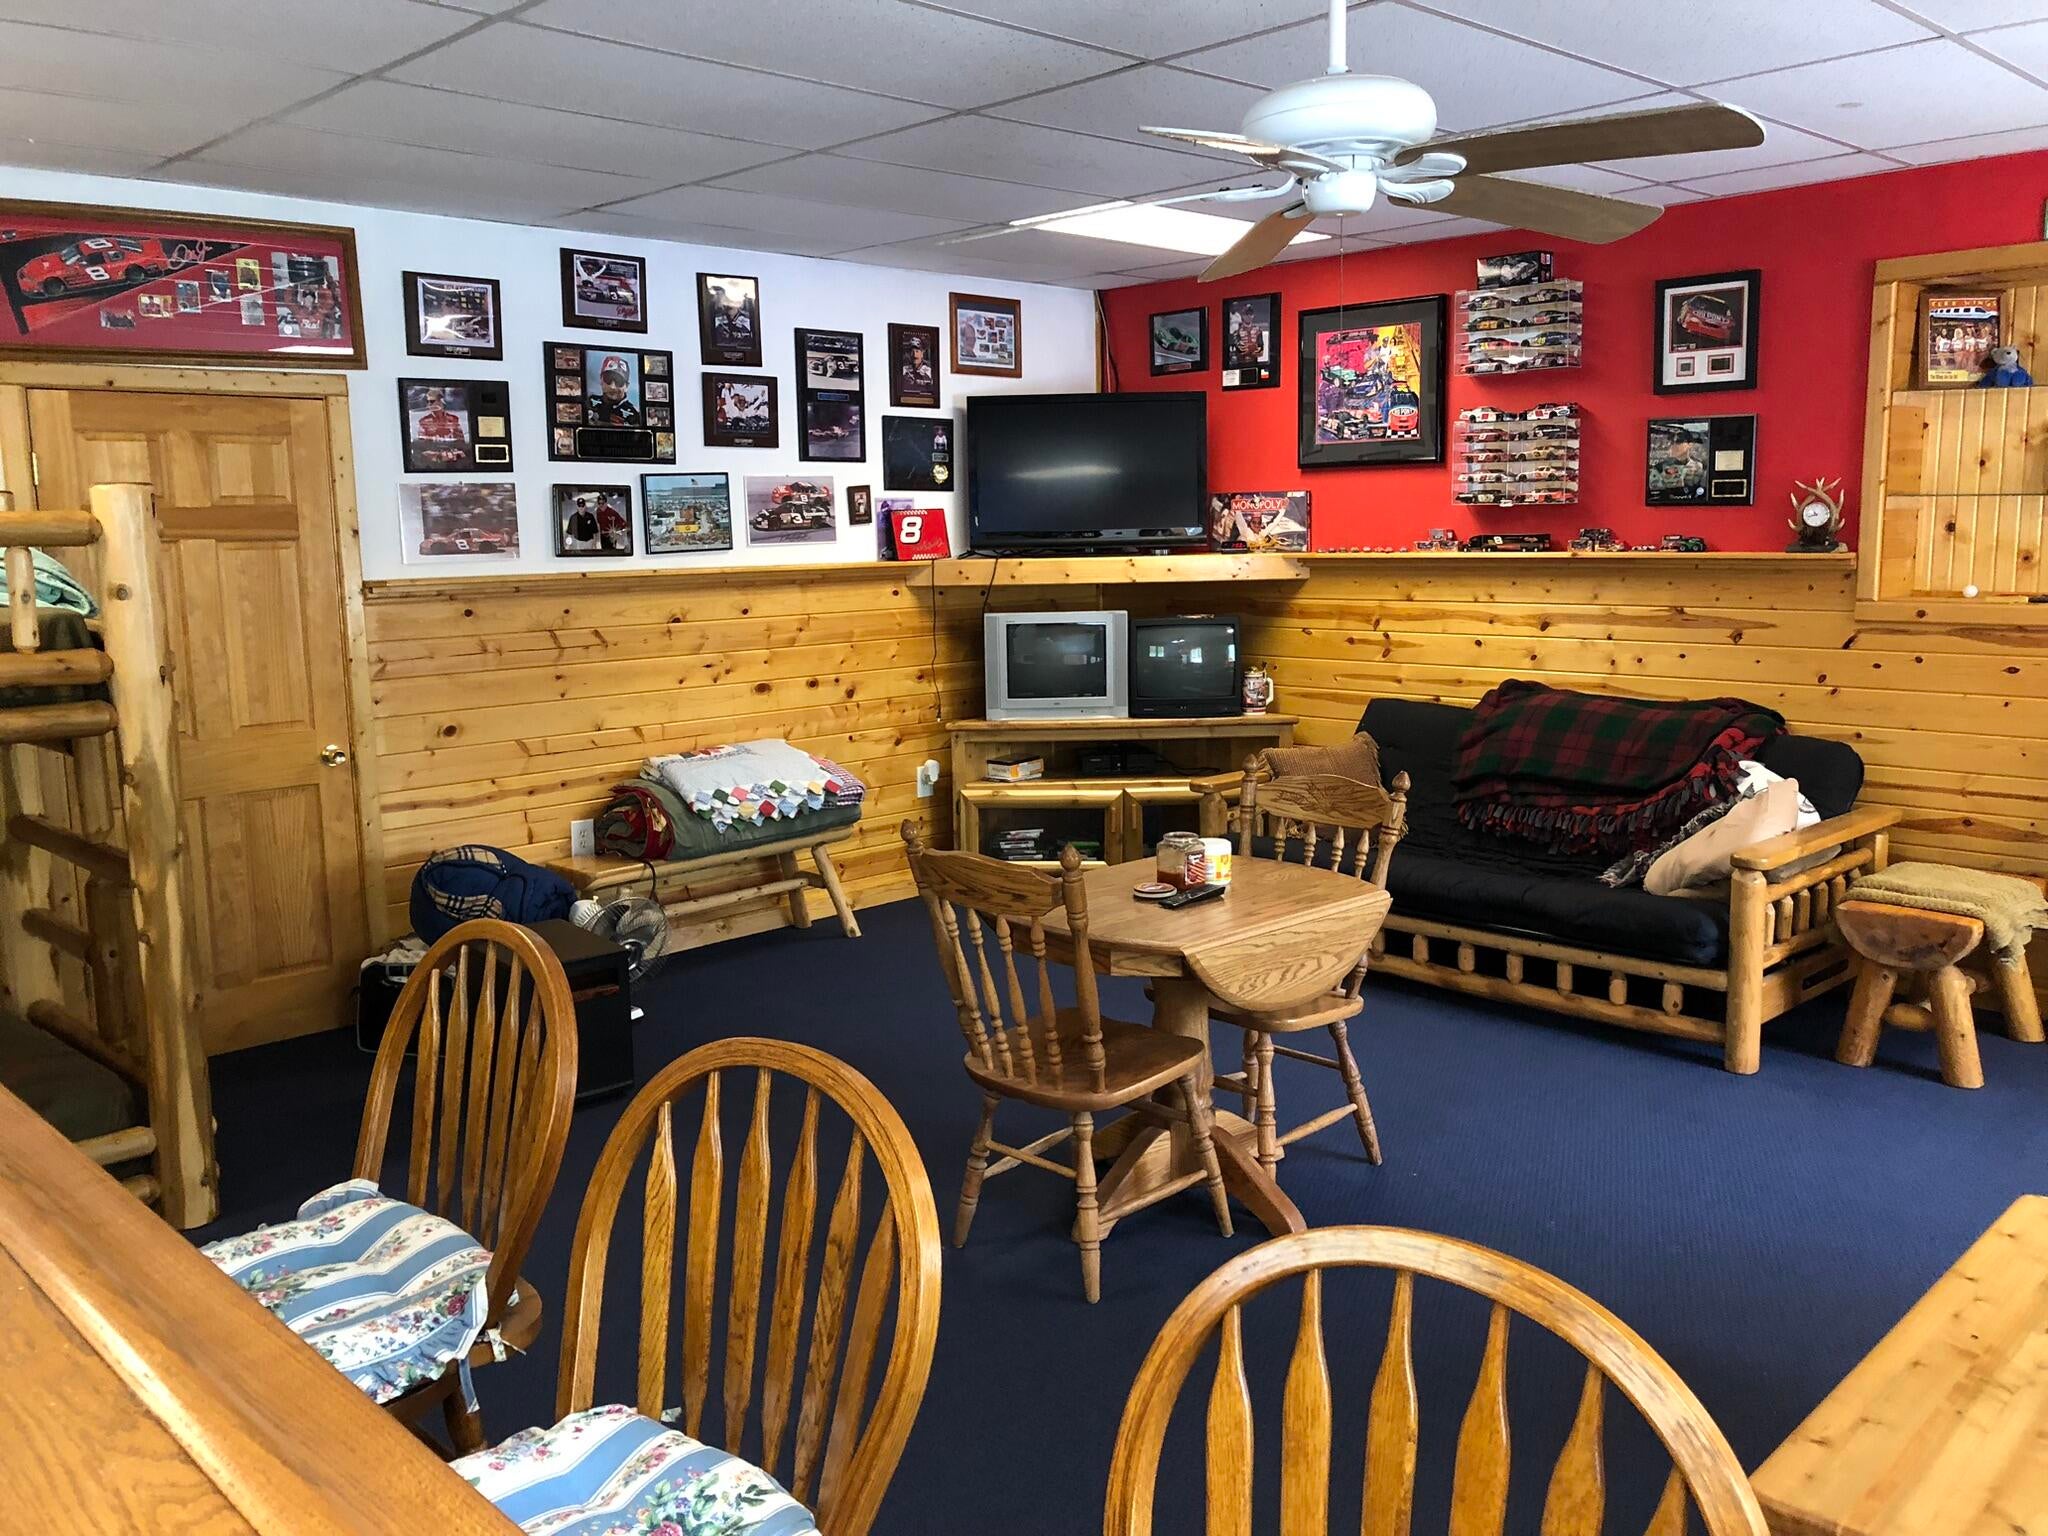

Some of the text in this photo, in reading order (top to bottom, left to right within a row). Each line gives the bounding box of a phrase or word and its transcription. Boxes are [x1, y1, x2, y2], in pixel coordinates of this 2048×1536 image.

[85, 266, 110, 281] 8
[610, 291, 618, 300] 3
[837, 361, 845, 370] 3
[800, 494, 808, 502] 8
[1232, 500, 1281, 510] MONOPOLY
[790, 513, 803, 524] 3
[899, 516, 923, 544] 8
[455, 539, 470, 550] 8
[1493, 536, 1503, 545] 8
